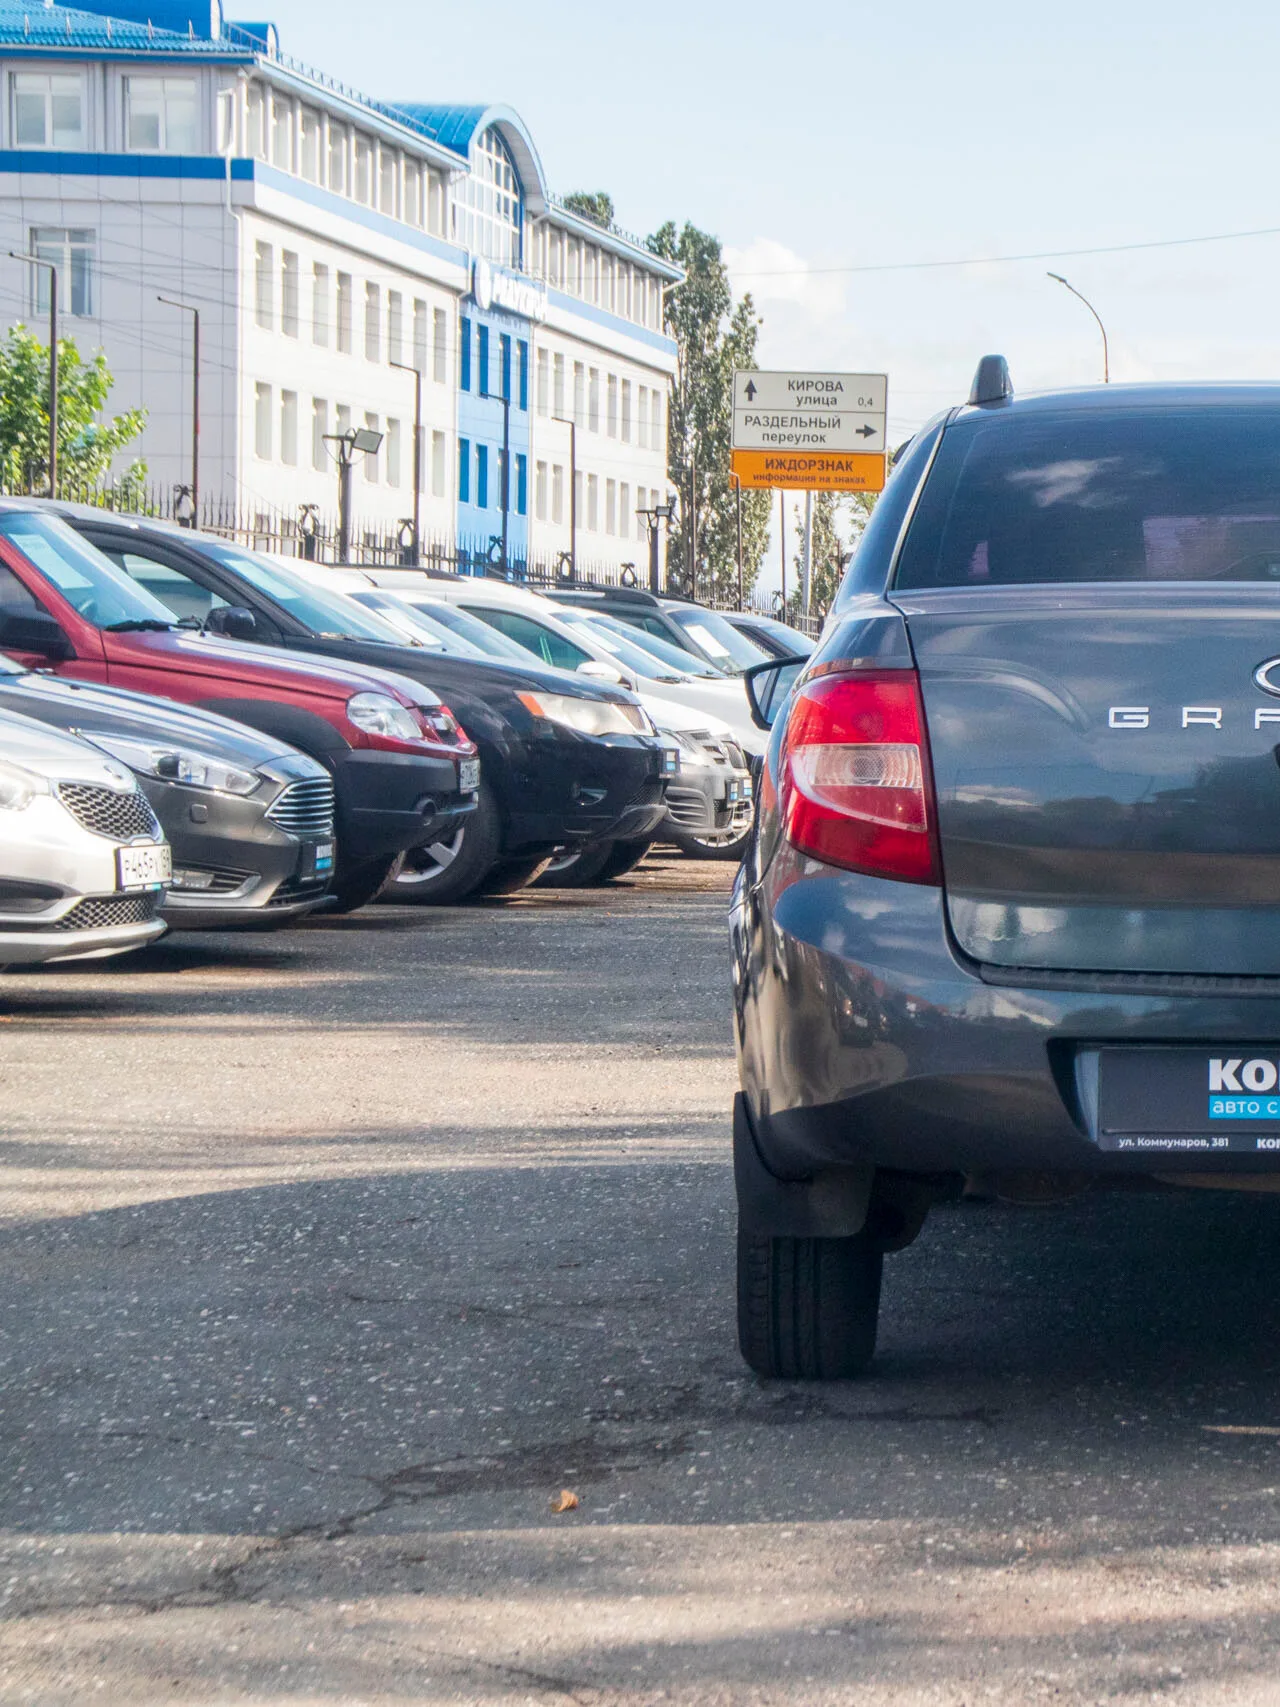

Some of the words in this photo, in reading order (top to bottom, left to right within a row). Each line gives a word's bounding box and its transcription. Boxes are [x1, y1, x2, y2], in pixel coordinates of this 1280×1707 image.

[788, 379, 844, 392] КИРОВА
[796, 395, 838, 408] улица
[857, 397, 873, 407] 0,4
[744, 415, 841, 429] РАЗДЕЛЬНЫЙ
[762, 432, 826, 445] переулок
[765, 458, 853, 473] ИЖДОРЗНАК
[819, 476, 831, 484] на
[834, 477, 866, 485] знаках
[1213, 1101, 1260, 1114] авто
[1267, 1102, 1278, 1114] с
[1119, 1139, 1135, 1148] ул.
[1137, 1138, 1210, 1148] Коммунаров,
[1212, 1138, 1229, 1147] 381
